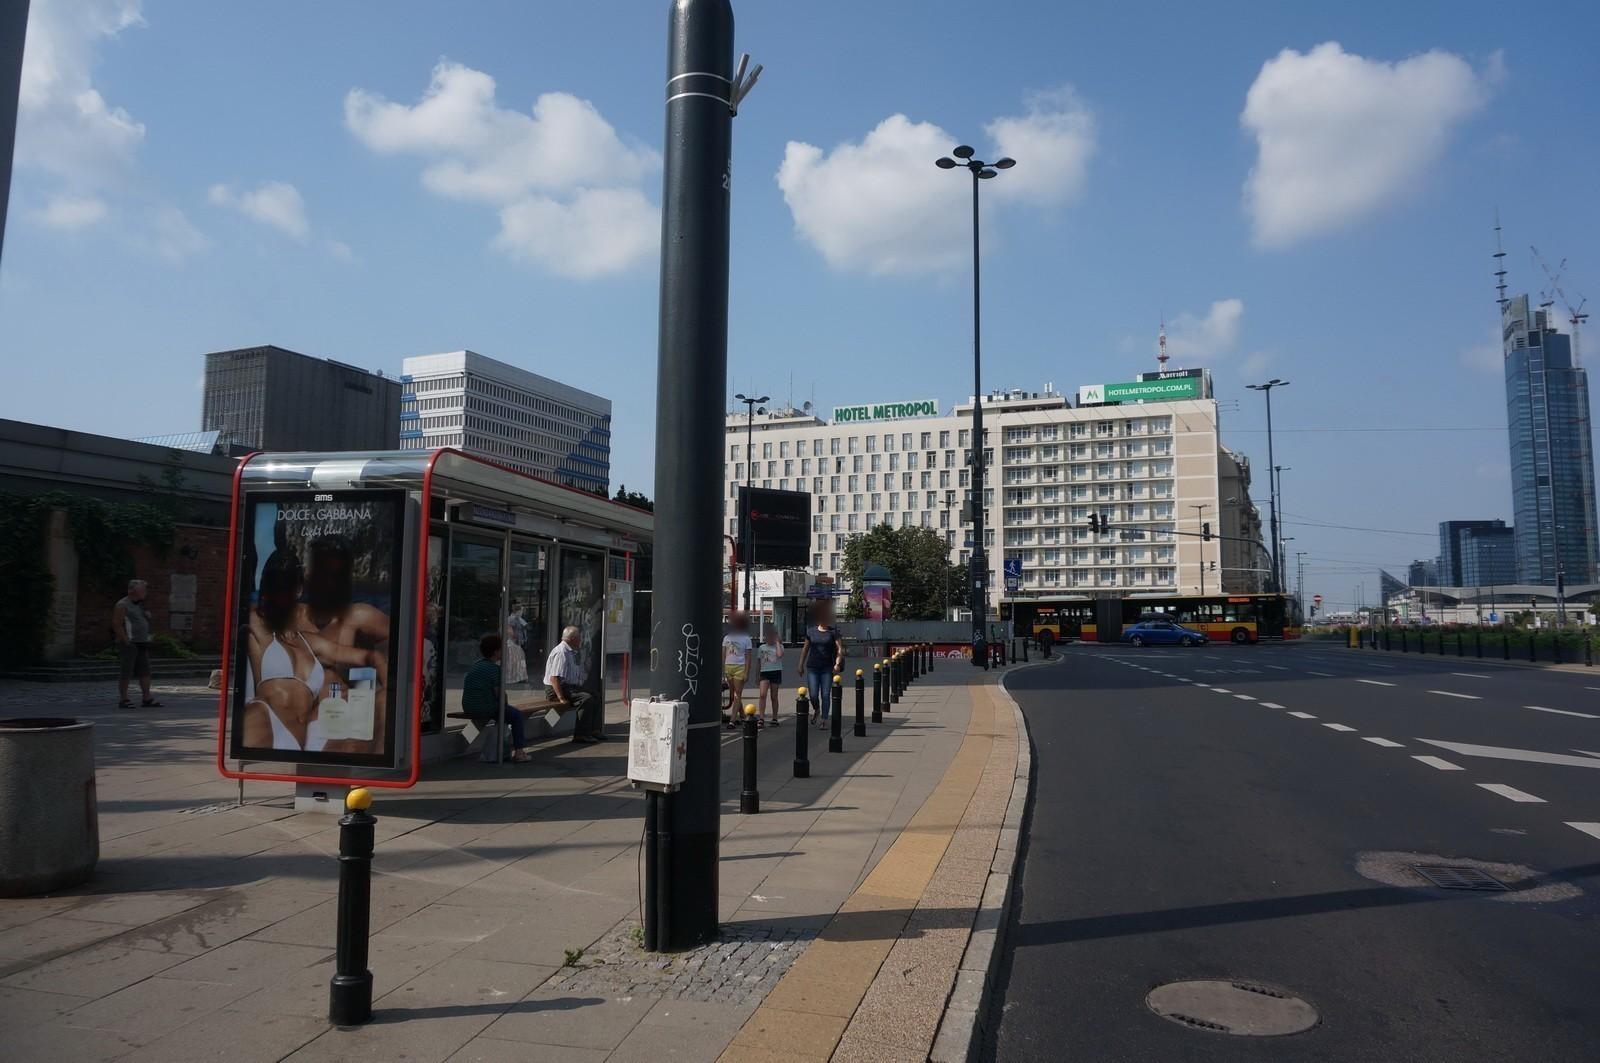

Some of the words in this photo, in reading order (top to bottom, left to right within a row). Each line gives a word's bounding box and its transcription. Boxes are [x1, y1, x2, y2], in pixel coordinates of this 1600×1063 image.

[1108, 384, 1193, 397] HOTELMETROPOL.COM.PL
[834, 406, 871, 422] HOTEL
[873, 401, 937, 419] METROPOL
[314, 494, 333, 502] ams
[277, 509, 310, 521] DOLCE
[316, 508, 372, 521] GABBANA
[300, 525, 322, 538] light
[323, 523, 342, 536] blue
